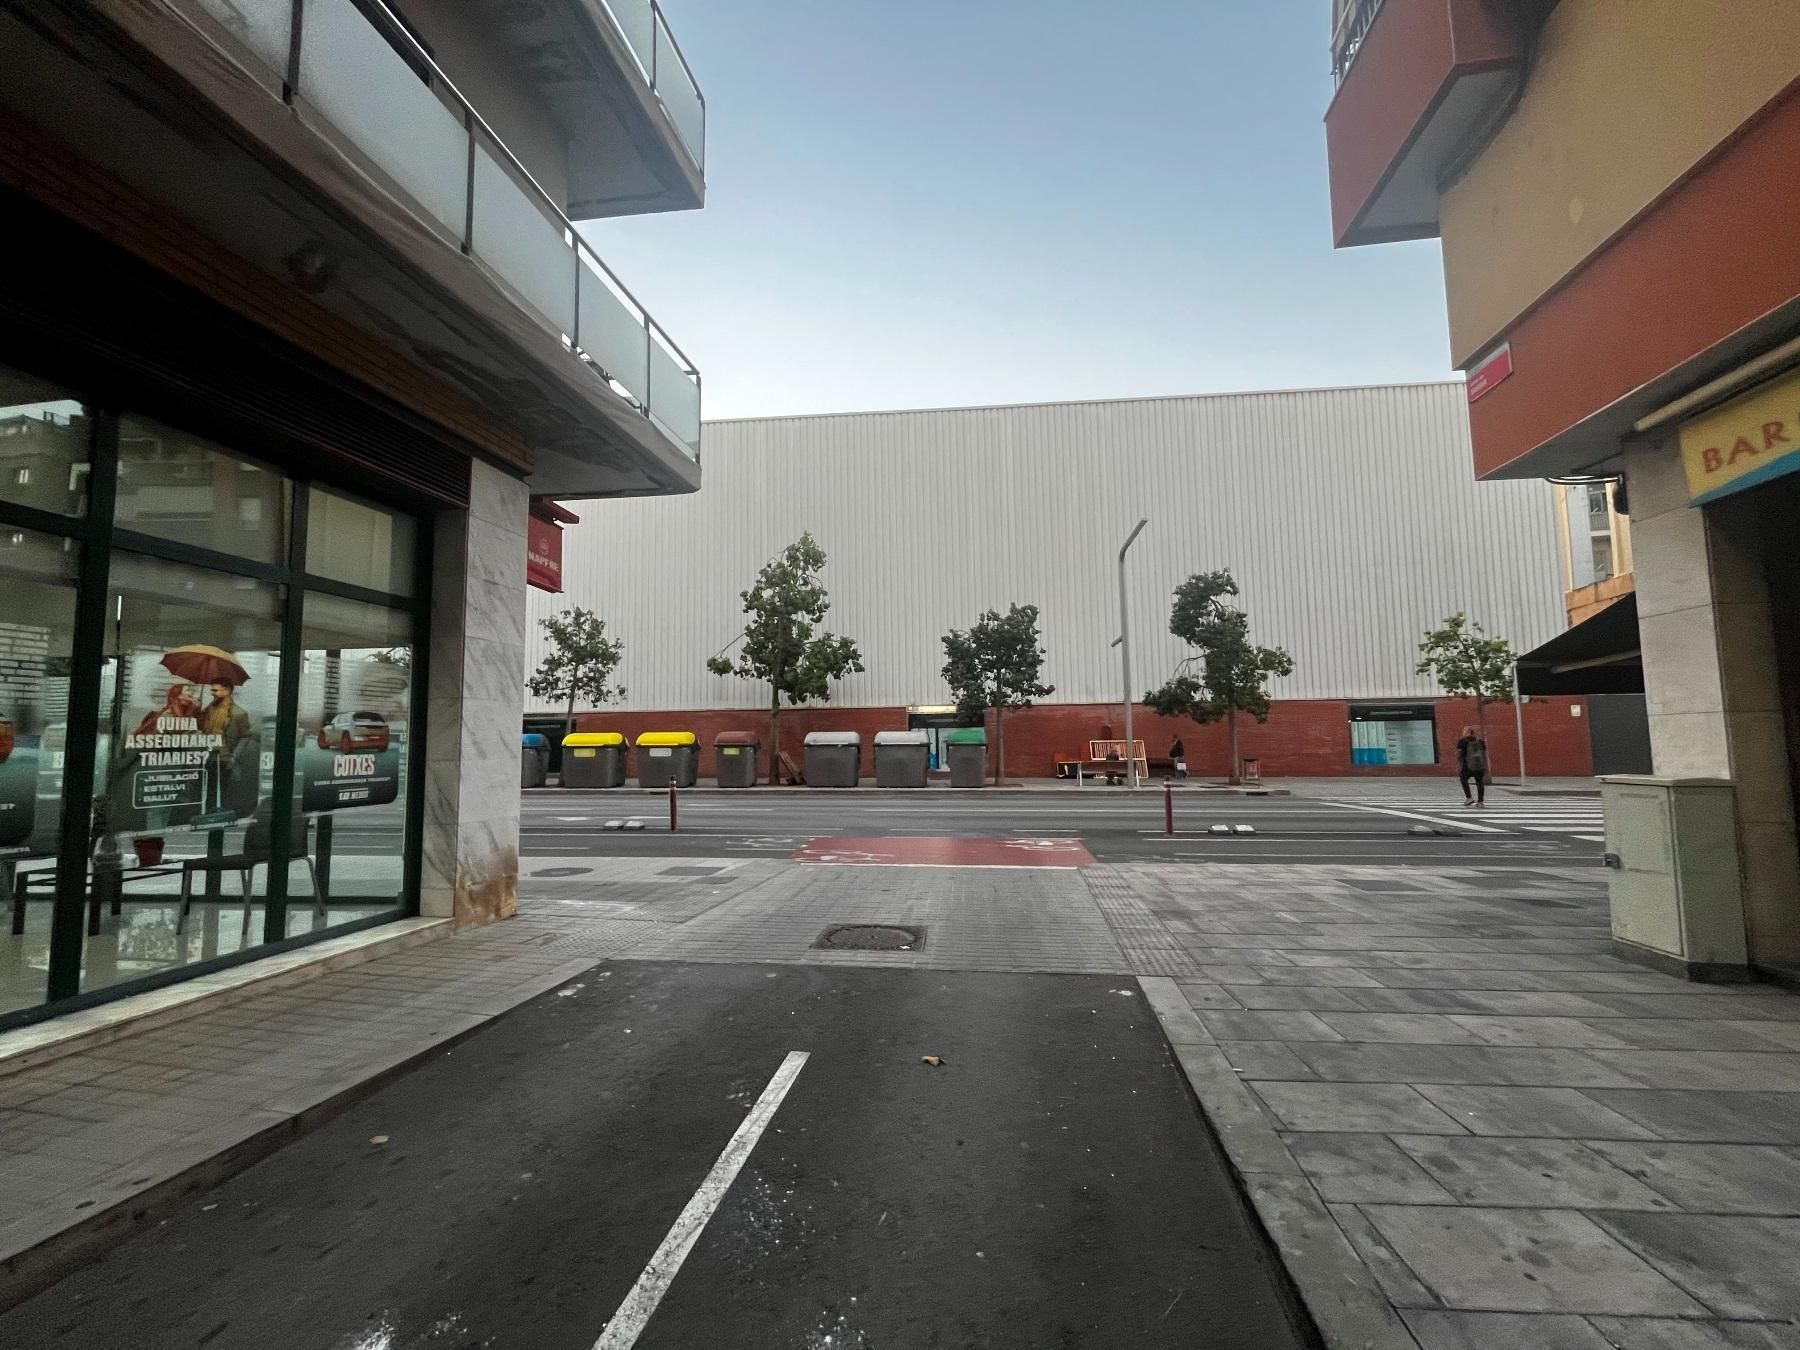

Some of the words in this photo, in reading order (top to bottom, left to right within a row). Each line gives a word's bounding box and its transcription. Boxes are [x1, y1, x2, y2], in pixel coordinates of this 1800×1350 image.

[1702, 421, 1790, 474] BAR
[528, 550, 560, 572] MAPFRE
[157, 716, 198, 734] QUINA
[124, 734, 223, 752] ASSEGURANÇA
[139, 751, 210, 767] TRIARIES?
[334, 754, 375, 777] COTXES
[143, 783, 186, 792] ESTALVI
[143, 793, 178, 802] SALUT
